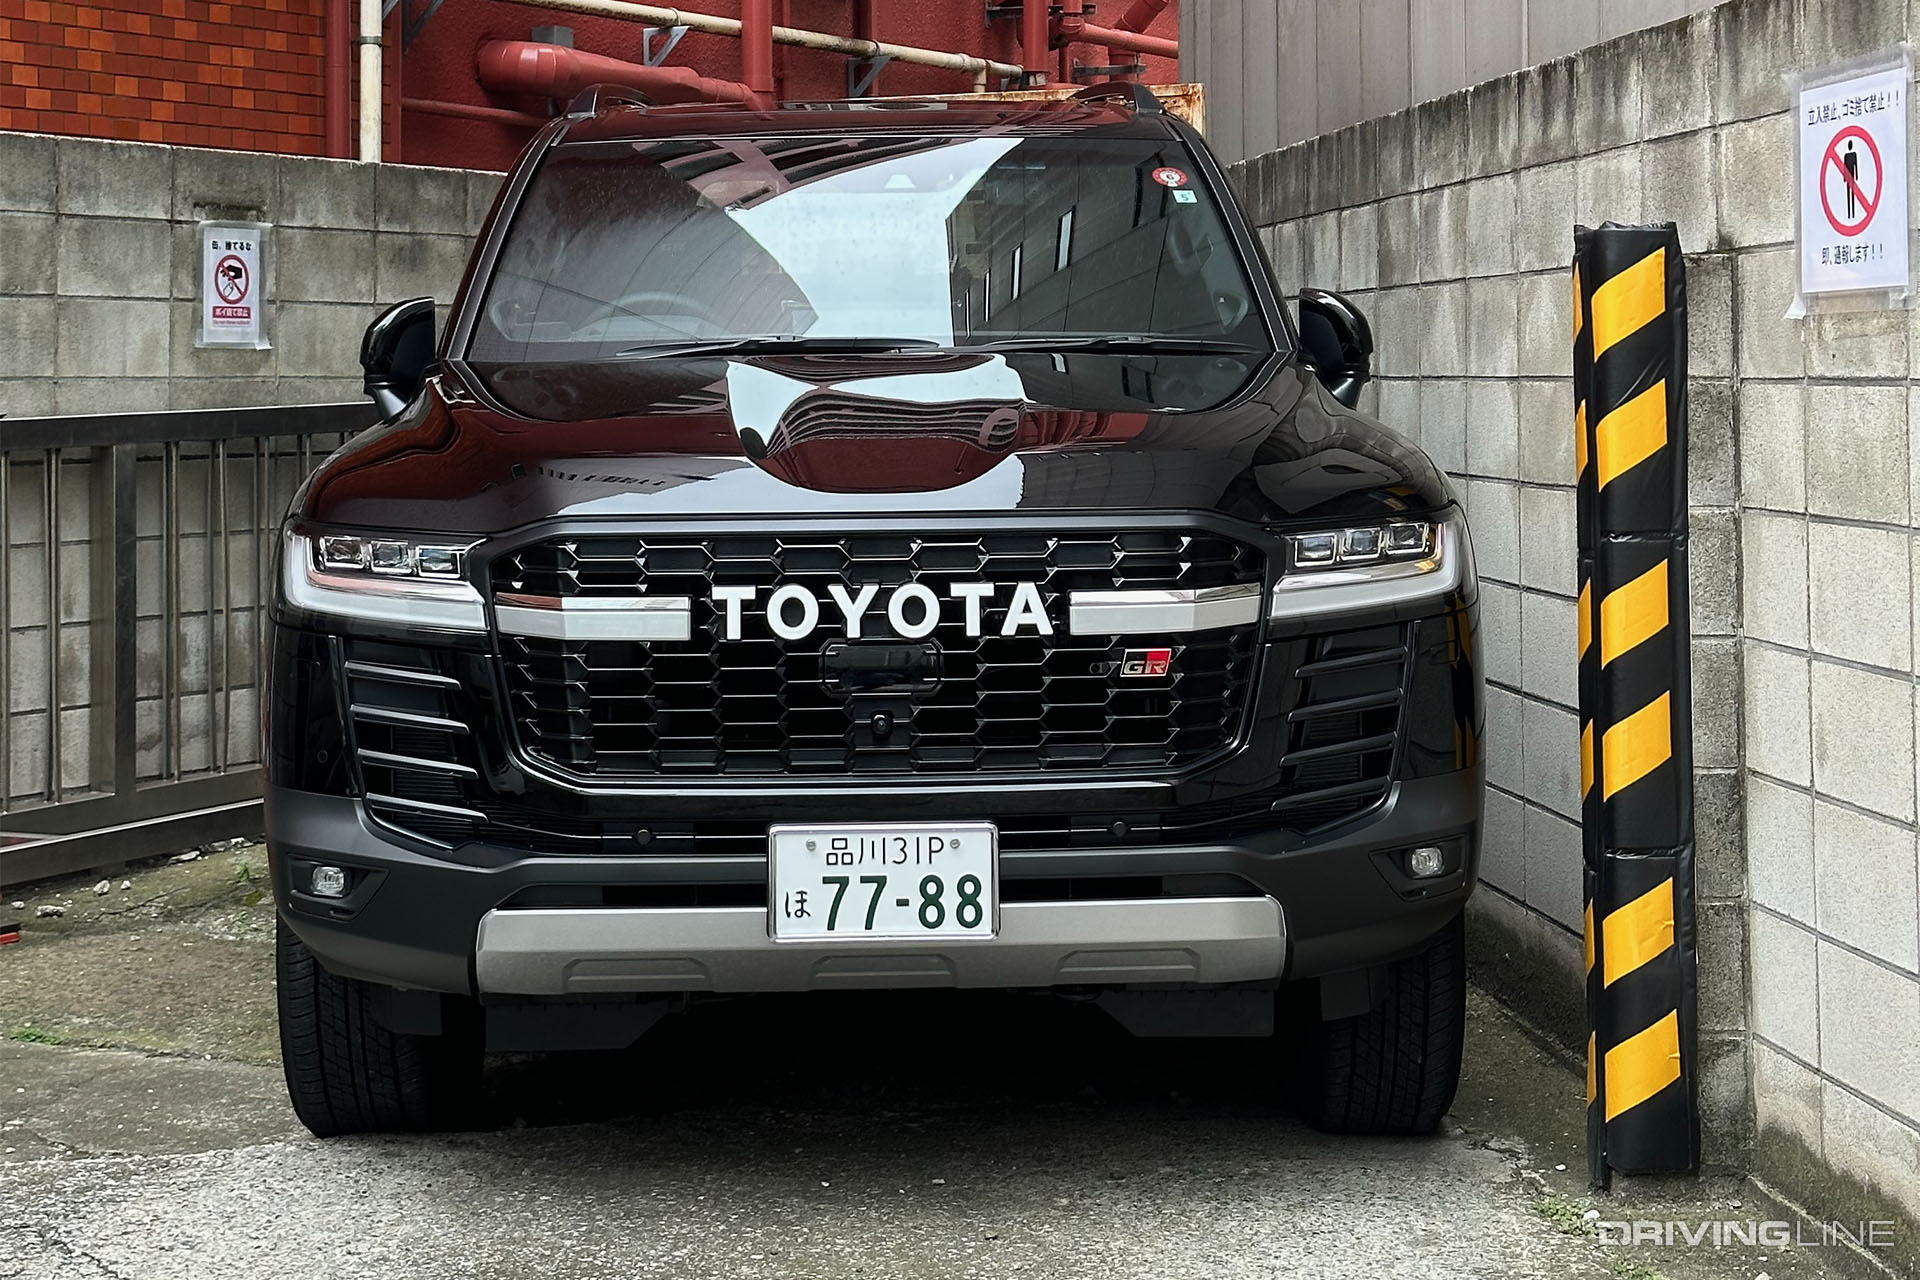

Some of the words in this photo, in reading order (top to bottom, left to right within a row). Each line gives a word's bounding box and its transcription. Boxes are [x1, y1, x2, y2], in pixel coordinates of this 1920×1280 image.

[711, 582, 1054, 640] TOYOTA
[1123, 660, 1167, 675] GR
[785, 890, 811, 918] ほ
[822, 874, 983, 931] 77-88
